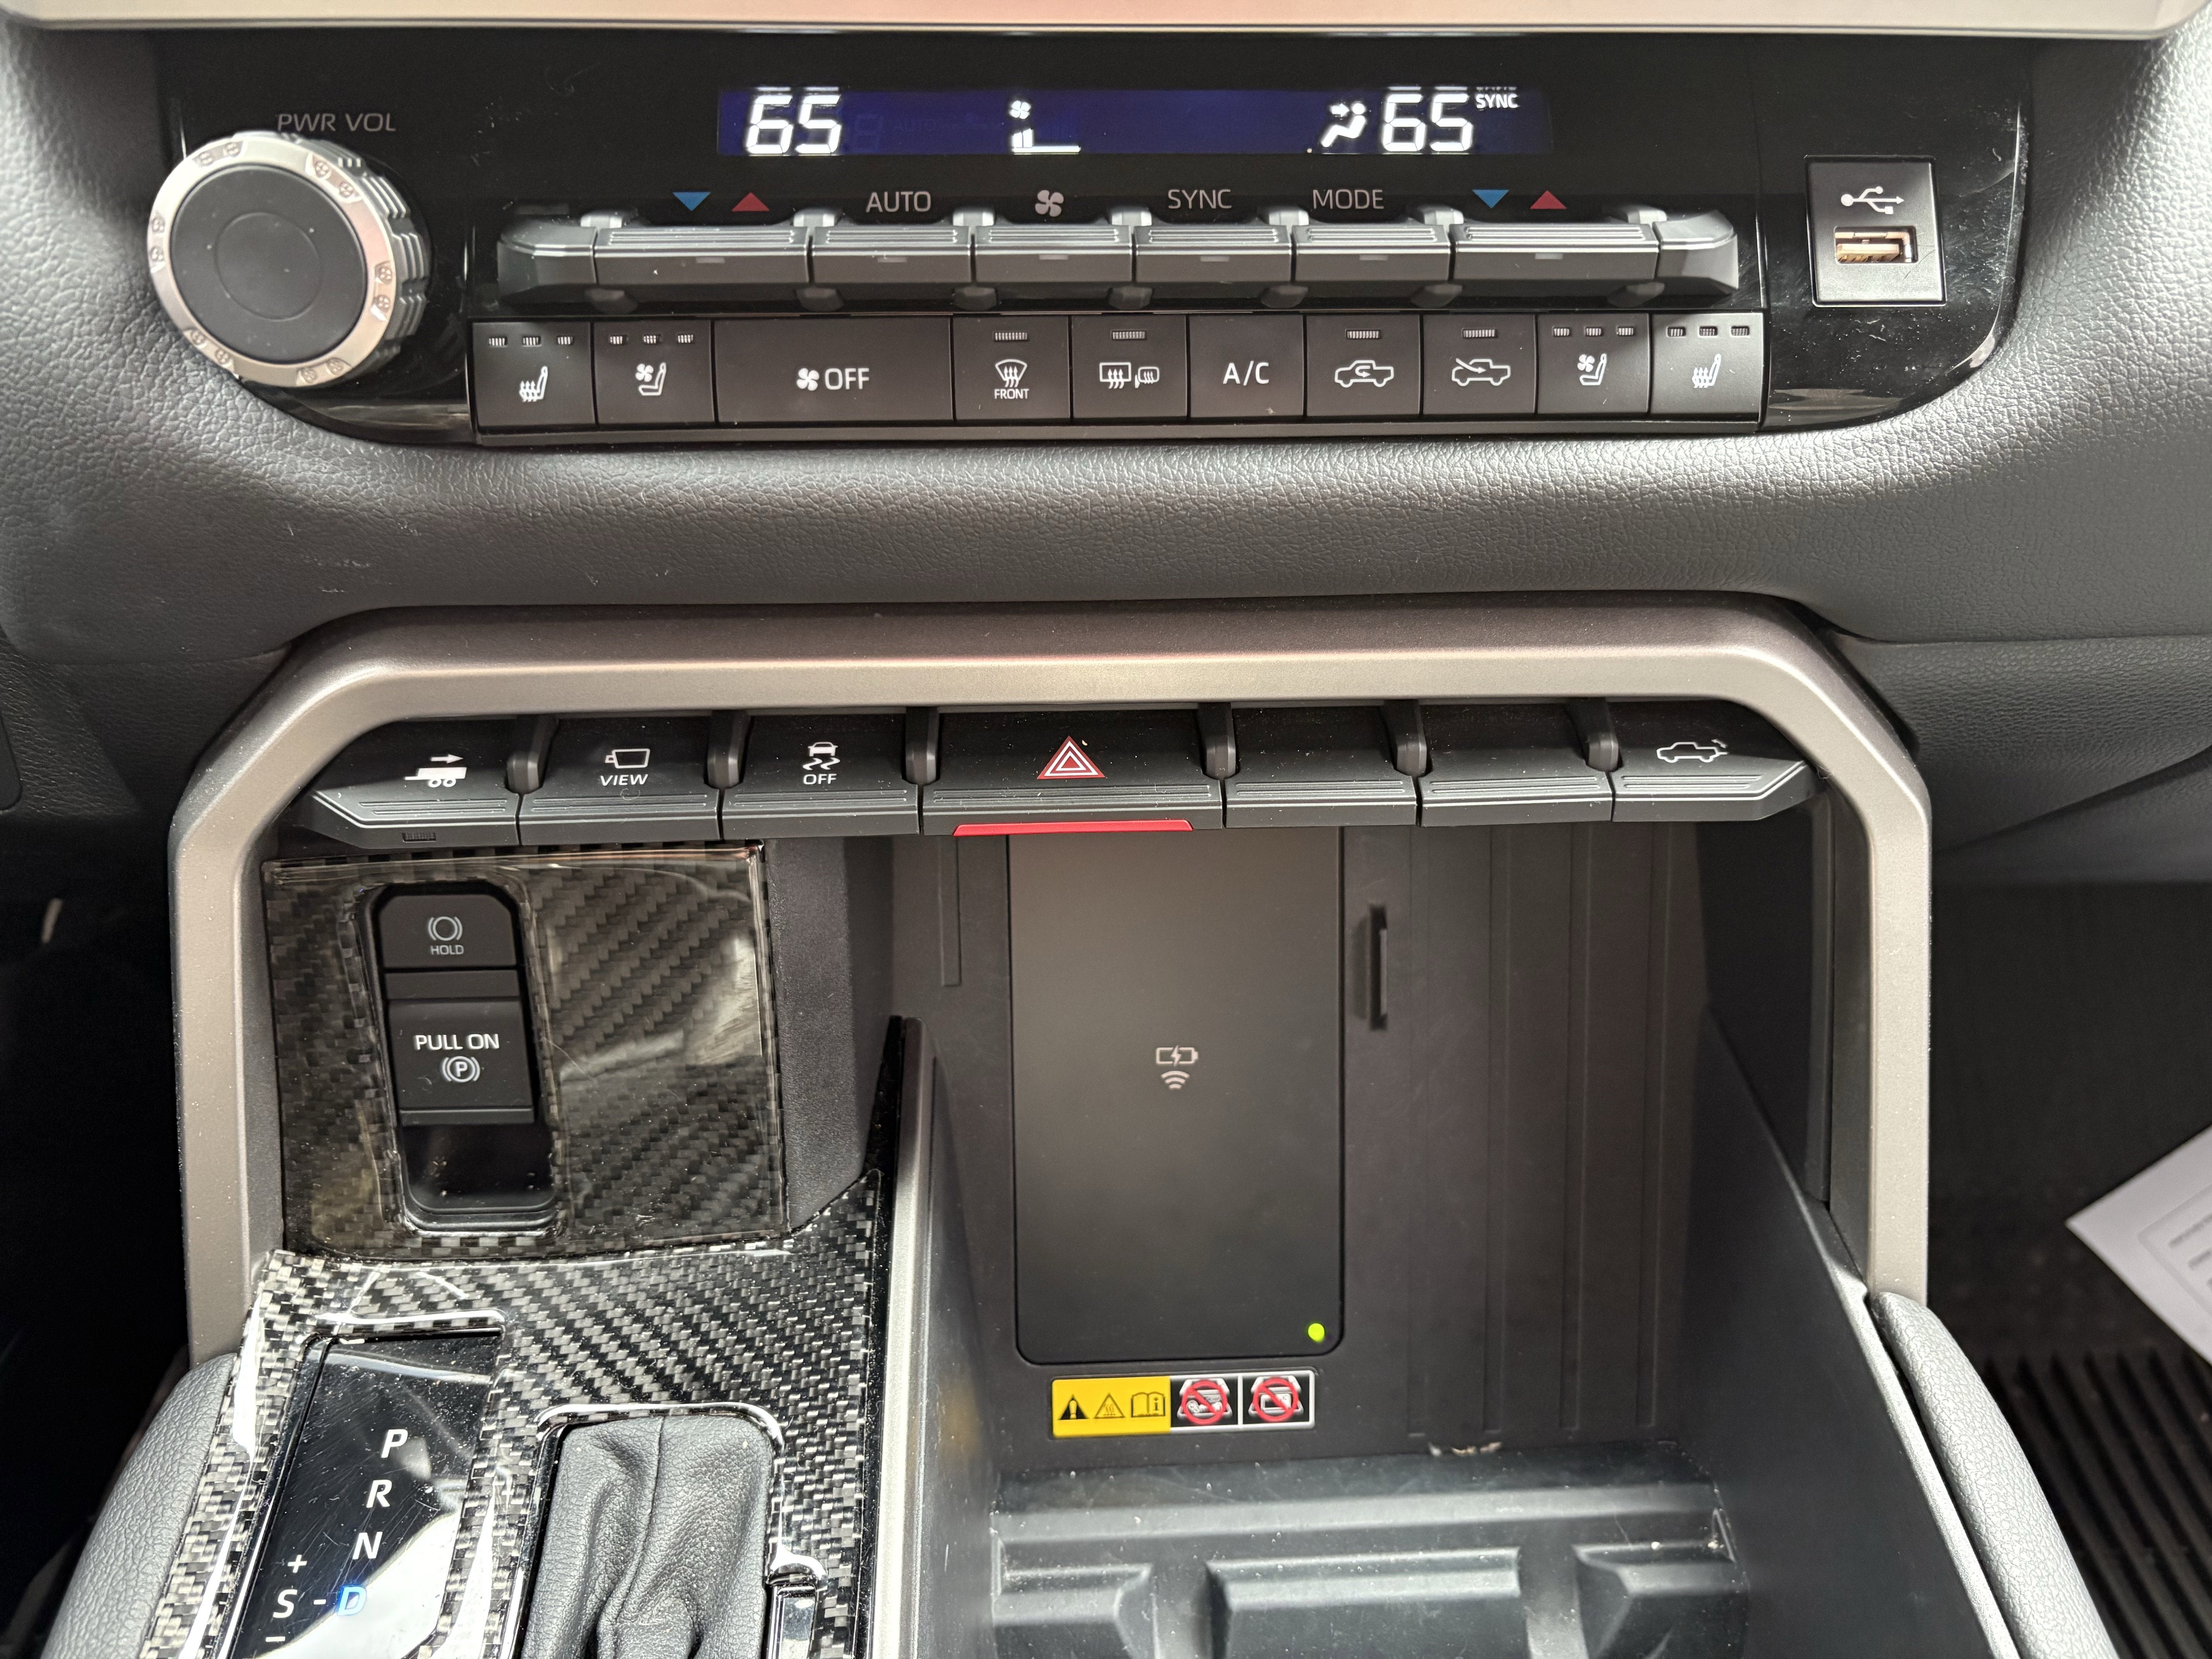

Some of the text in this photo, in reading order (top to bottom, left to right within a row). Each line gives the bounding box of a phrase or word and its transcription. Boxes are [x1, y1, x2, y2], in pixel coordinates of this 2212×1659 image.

[1475, 93, 1518, 108] SYNC
[277, 113, 396, 132] PWR VOL
[746, 94, 842, 154] 65
[1382, 93, 1473, 151] 65
[866, 191, 931, 213] AUTO
[1168, 189, 1232, 209] SYNC
[1313, 189, 1384, 209] MODE
[824, 368, 869, 390] OFF
[1223, 361, 1269, 386] A/C
[994, 388, 1029, 399] FRONT
[600, 774, 648, 786] VIEW
[803, 773, 837, 785] OFF
[430, 945, 464, 955] HOLD
[415, 1034, 500, 1050] PULL ON
[455, 1061, 468, 1077] P
[381, 1429, 408, 1459] P
[366, 1479, 392, 1508] R
[352, 1531, 383, 1560] N
[273, 1586, 367, 1618] S D
